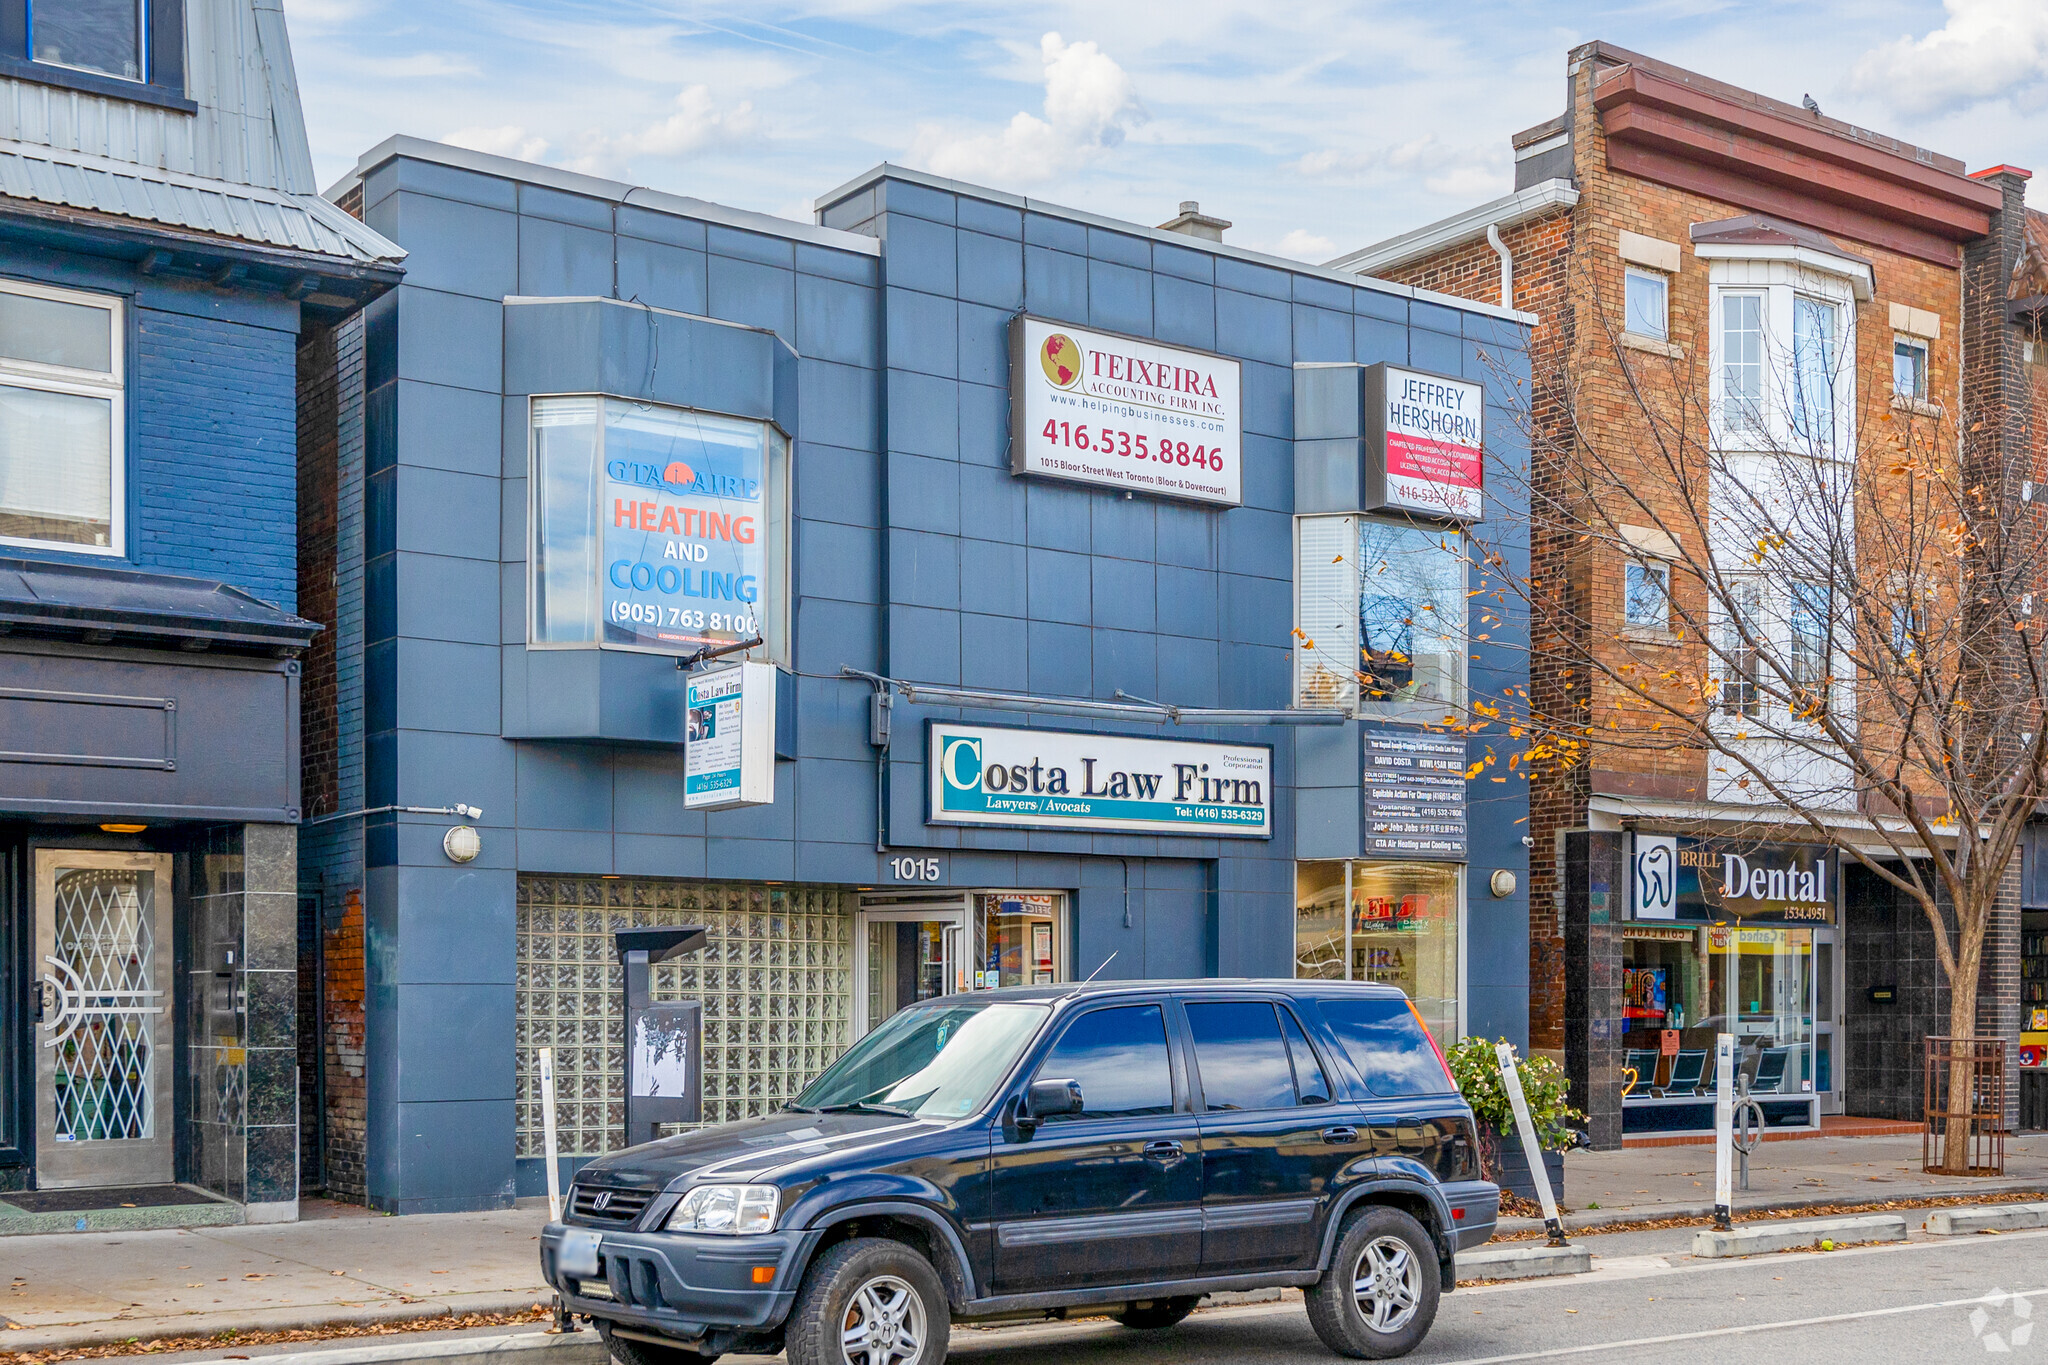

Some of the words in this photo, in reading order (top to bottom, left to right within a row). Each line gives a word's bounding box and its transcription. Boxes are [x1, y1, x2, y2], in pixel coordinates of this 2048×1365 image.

[1089, 350, 1219, 399] TEIXEIRA
[1090, 381, 1166, 405] ACCOUNTING
[1170, 396, 1198, 411] FIRM
[1202, 402, 1225, 416] INC.
[1402, 378, 1465, 411] JEFFREY
[1050, 393, 1224, 433] www.helpingbusinesses.com
[1390, 401, 1476, 439] HERSHORN
[1042, 418, 1224, 472] 416.535.8846
[1389, 439, 1415, 450] CHARTERED
[608, 459, 665, 488] GTA
[691, 472, 760, 500] AIRE
[1040, 457, 1059, 469] 1015
[1060, 460, 1081, 473] Bloor
[1082, 463, 1105, 477] Street
[1105, 467, 1124, 479] West
[1125, 471, 1154, 484] Toronto
[1155, 475, 1177, 488] (Bloor
[1178, 479, 1184, 488] &
[1185, 480, 1227, 496] Dovercourt)
[1399, 485, 1468, 509] 416-535-8846
[615, 498, 755, 544] HEATING
[663, 540, 709, 562] AND
[610, 560, 757, 603] COOLING
[611, 600, 663, 627] (905)
[668, 607, 704, 629] 763
[709, 612, 758, 634] 8100
[691, 688, 710, 703] Costa
[711, 686, 723, 698] Law
[726, 681, 741, 695] Firm
[1223, 754, 1263, 764] Professional
[1223, 761, 1263, 770] Corporation
[1375, 756, 1392, 765] DAVID
[1394, 757, 1412, 766] COSTA
[943, 739, 1070, 795] Costa
[1081, 757, 1162, 800] Law
[1172, 762, 1263, 806] Firm
[986, 796, 1037, 812] Lawyers
[1045, 799, 1091, 814] Avocats
[1175, 806, 1193, 818] Tel:
[1195, 807, 1219, 820] (416)
[1221, 808, 1263, 821] 535-6329
[1378, 804, 1415, 812] Upstanding
[1422, 808, 1436, 818] (416)
[1373, 822, 1388, 831] Jobs
[1389, 822, 1403, 832] Jobs
[1404, 823, 1418, 832] Jobs
[1376, 839, 1386, 848] GTA
[1388, 840, 1396, 848] Air
[1398, 840, 1419, 850] Heating
[1431, 840, 1451, 851] Cooling
[890, 857, 940, 882] 1015
[1680, 851, 1721, 868] BRILL
[1721, 853, 1827, 903] Dental
